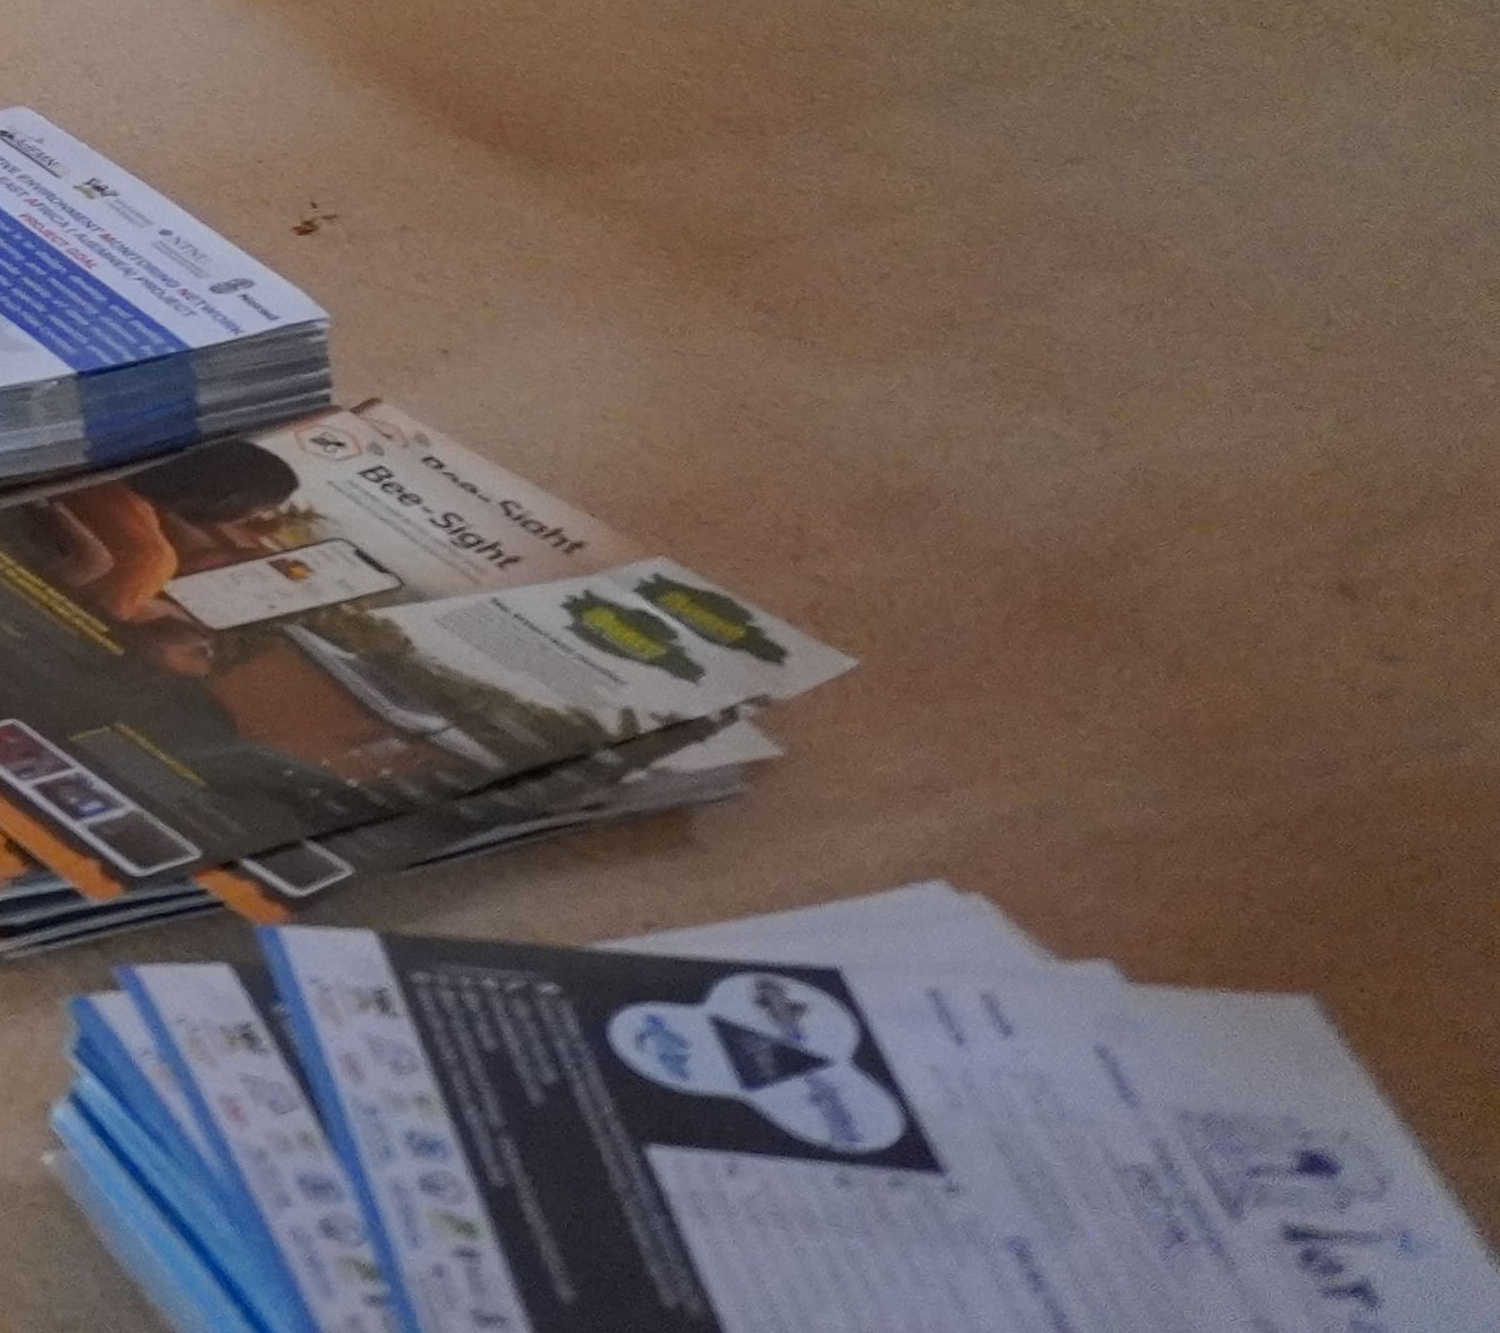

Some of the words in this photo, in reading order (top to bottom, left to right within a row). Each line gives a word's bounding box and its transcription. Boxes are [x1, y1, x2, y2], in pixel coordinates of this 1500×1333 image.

[15, 174, 103, 232] ENVIRONMENT
[97, 232, 183, 288] MONITORING
[17, 212, 71, 247] PROJECT
[64, 246, 102, 269] GOAL
[23, 197, 73, 228] AFRICA
[131, 275, 198, 317] PROJECT
[357, 463, 525, 573] Bee-Sight
